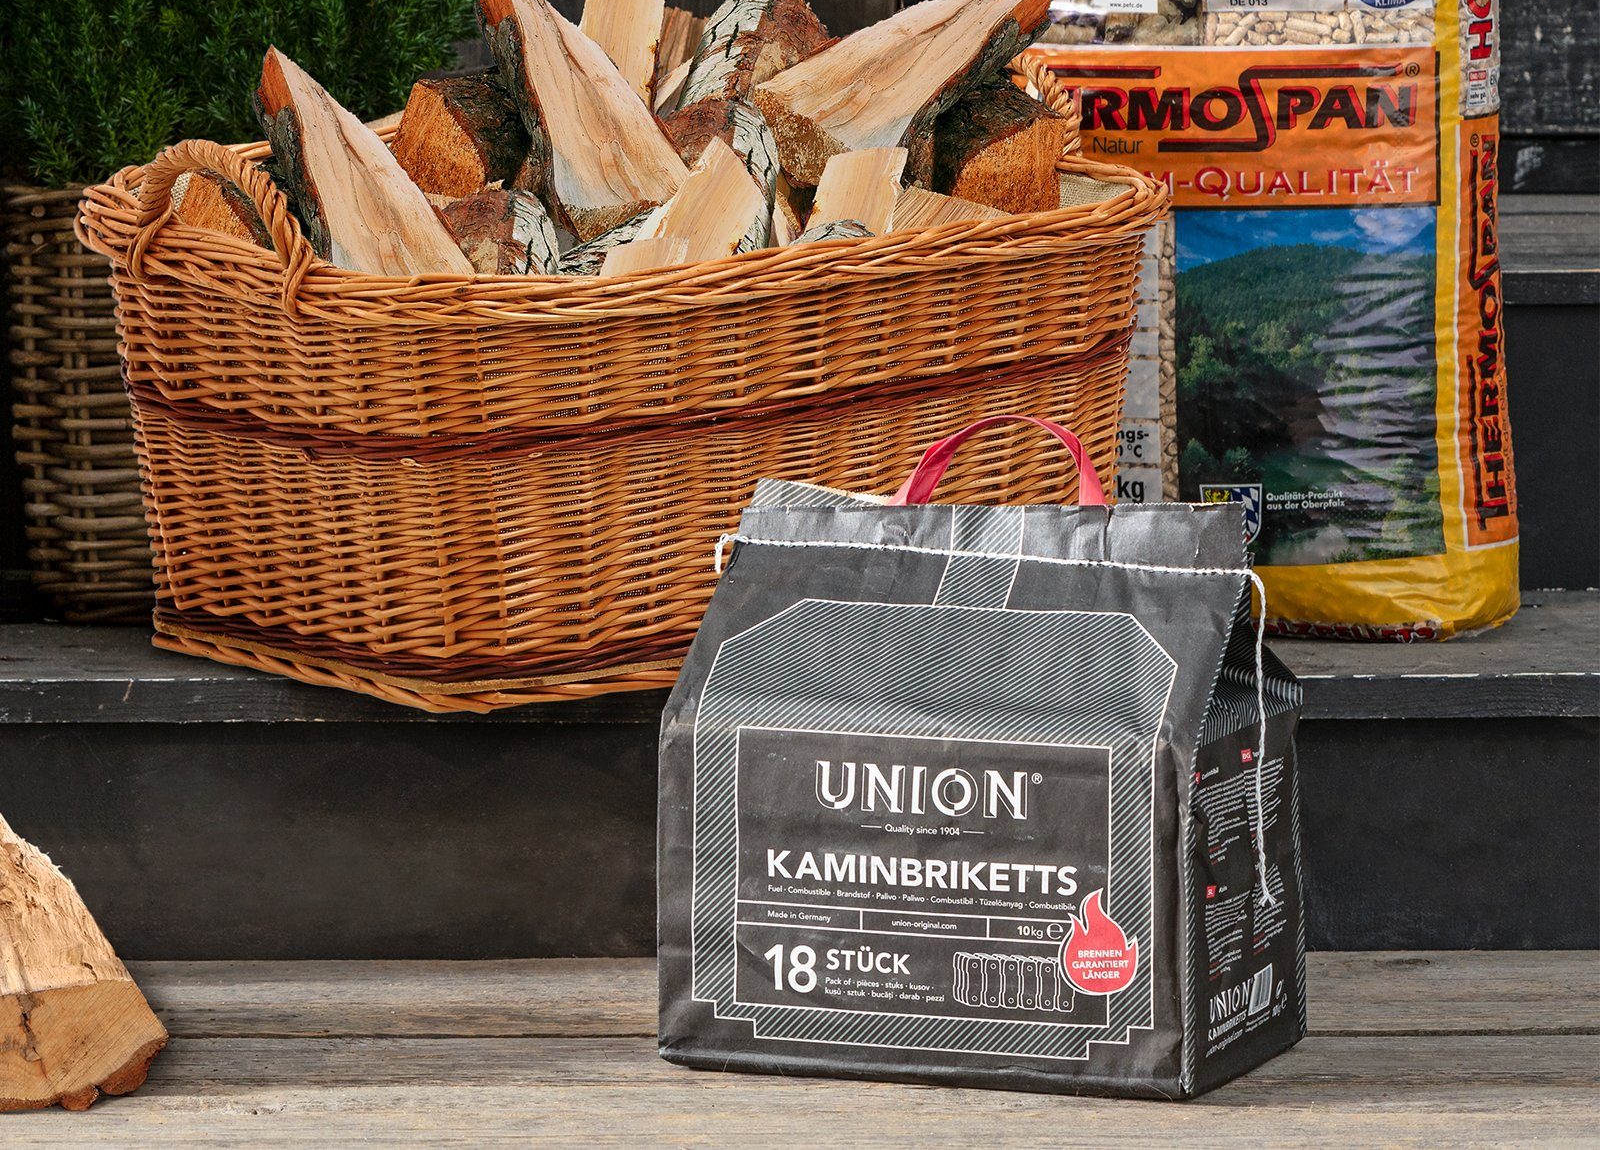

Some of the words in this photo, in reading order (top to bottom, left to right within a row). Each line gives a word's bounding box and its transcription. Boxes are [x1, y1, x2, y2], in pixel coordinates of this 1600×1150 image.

[1047, 63, 1418, 153] RMOSPAN
[1092, 136, 1143, 155] Natur
[1144, 160, 1421, 201] M-QUALITÄT
[1116, 429, 1149, 444] ngs-
[1117, 475, 1145, 503] kg
[1266, 490, 1344, 501] Qualitäts-Produkt
[1284, 501, 1299, 510] der
[1301, 500, 1345, 510] Oberpfalz
[815, 760, 1028, 820] UNION
[884, 823, 915, 836] Quality
[916, 825, 938, 835] since
[940, 826, 961, 836] 1904
[767, 848, 1078, 896] KAMINBRIKETTS
[768, 884, 783, 893] Fuel
[787, 886, 832, 897] Combustible
[836, 889, 872, 899] Brandstof
[876, 892, 897, 901] Palivo
[902, 894, 925, 903] Paliwo
[930, 895, 973, 906] Combustibil
[1028, 902, 1077, 912] Combustibile
[767, 910, 788, 919] Made
[790, 911, 797, 919] in
[798, 912, 832, 923] Germany
[891, 919, 957, 931] union-original.com
[1077, 950, 1122, 958] BRENNEN
[763, 944, 818, 994] 18
[826, 945, 911, 975] STÜCK
[1072, 960, 1130, 969] GARANTIERT
[1082, 970, 1120, 979] LÄNGER
[824, 976, 842, 985] Pack
[856, 979, 880, 988] pièces
[884, 981, 904, 989] stuks
[909, 982, 931, 991] kusov
[847, 988, 866, 997] sztuk
[898, 992, 921, 1001] darab
[925, 994, 945, 1003] pezzi
[1209, 978, 1252, 1024] UNION
[1208, 1008, 1248, 1042] KAMINBRIKETTS
